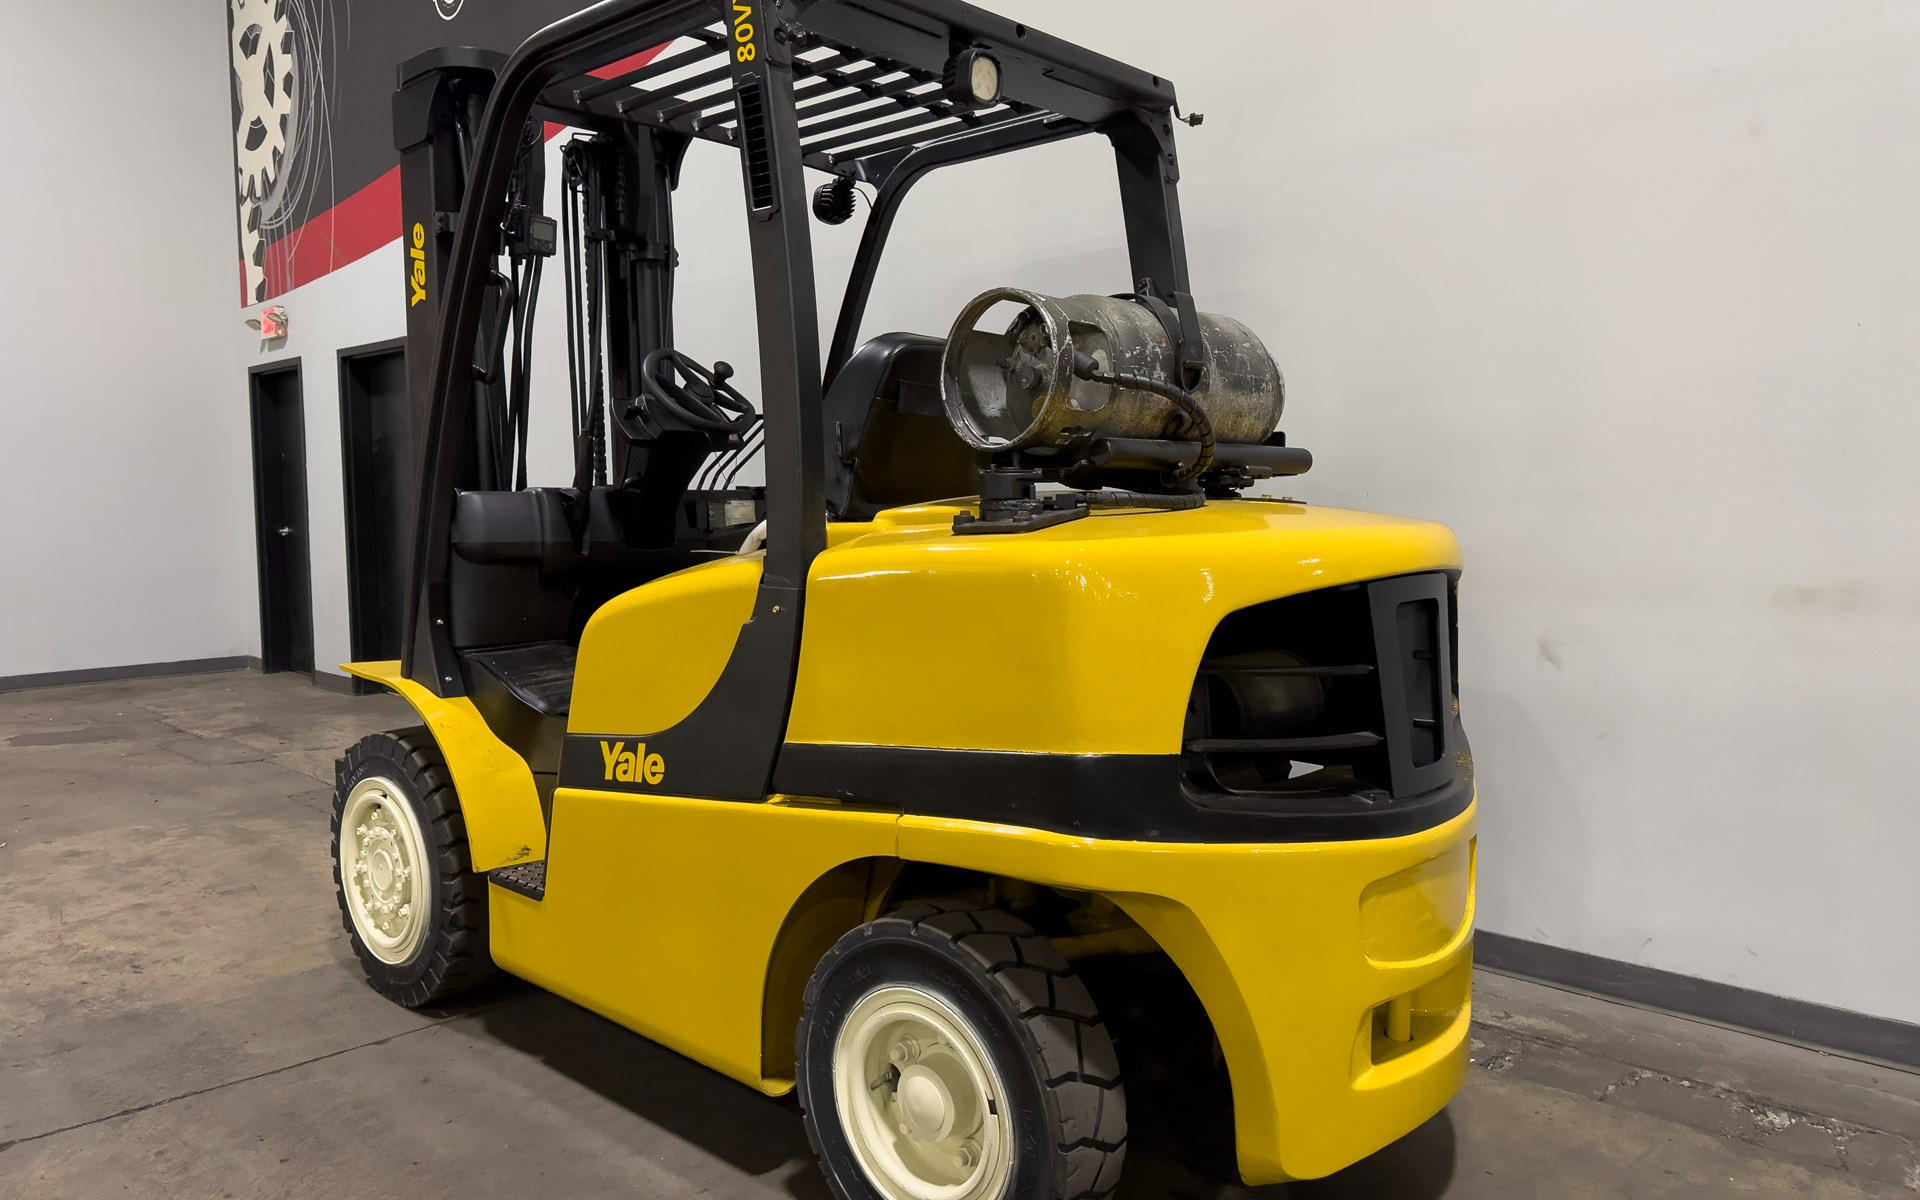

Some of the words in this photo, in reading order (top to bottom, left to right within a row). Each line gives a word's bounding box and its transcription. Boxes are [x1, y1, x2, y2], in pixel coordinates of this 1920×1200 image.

[732, 0, 756, 63] 80V
[410, 222, 426, 308] Yale
[600, 740, 666, 785] Yale
